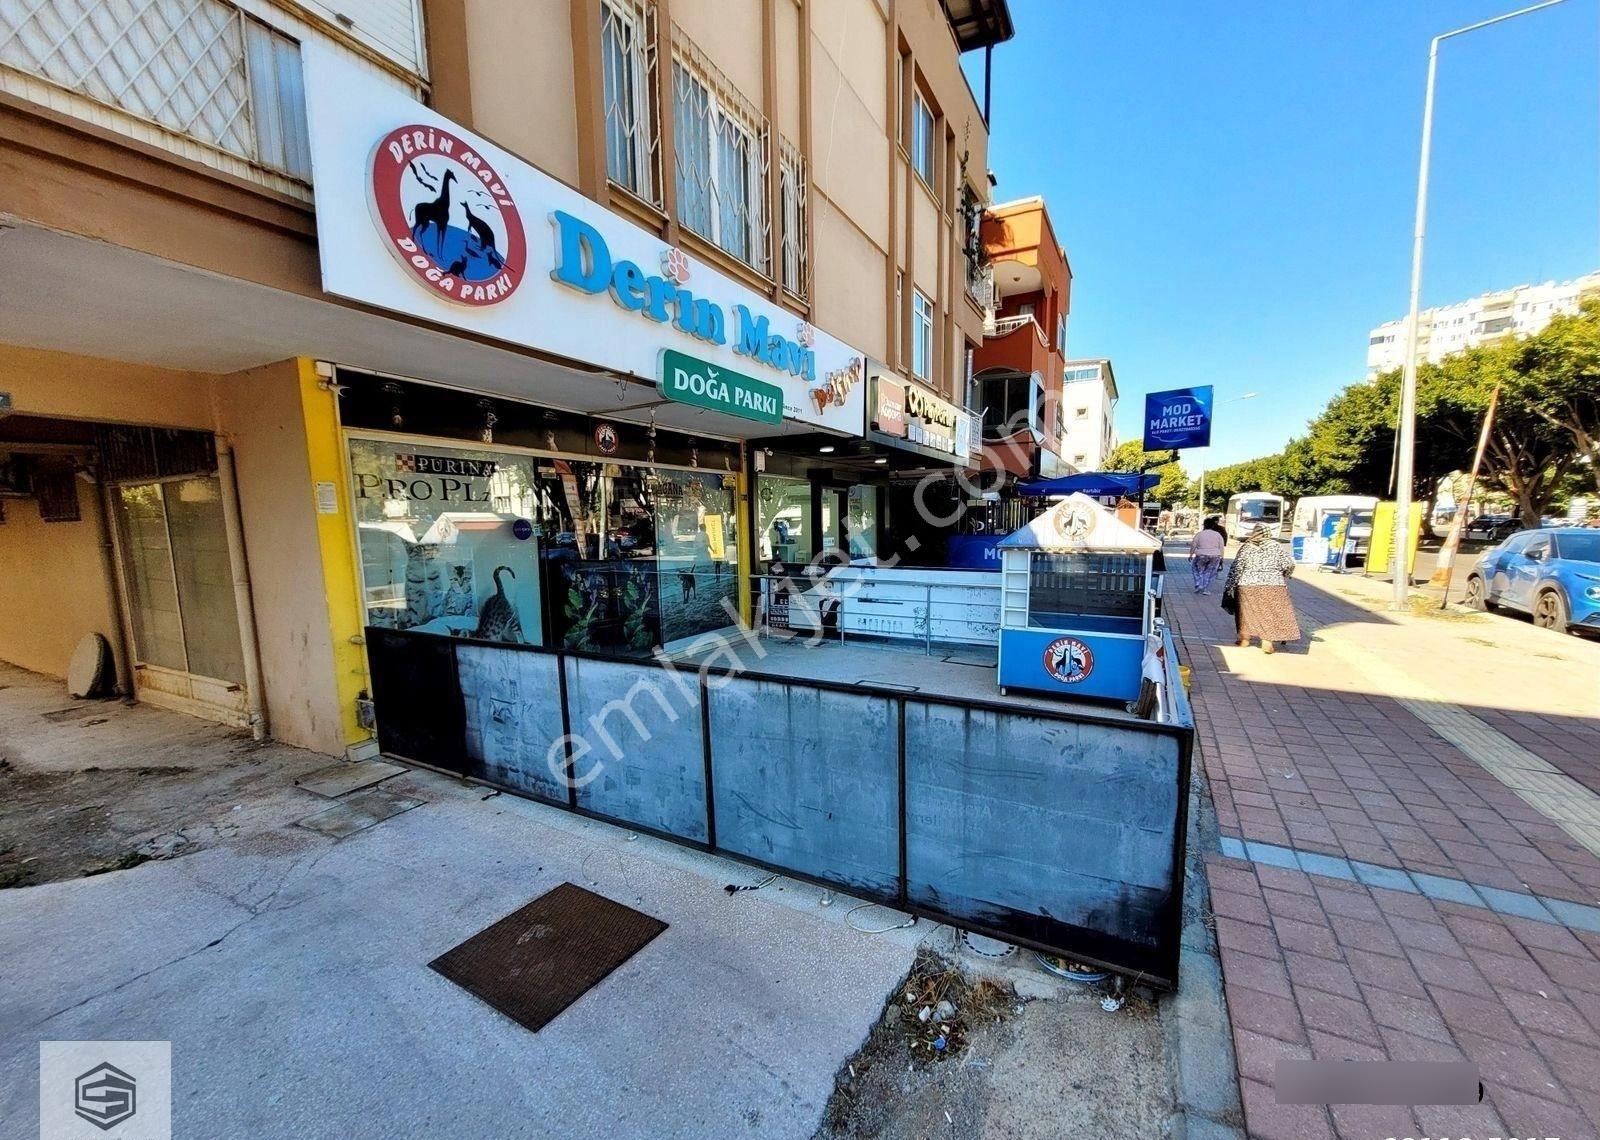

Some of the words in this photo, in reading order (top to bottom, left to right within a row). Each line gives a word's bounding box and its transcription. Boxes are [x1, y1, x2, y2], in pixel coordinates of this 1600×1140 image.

[397, 237, 454, 291] DOĞA
[460, 273, 513, 300] PARKI
[547, 210, 726, 347] Derin
[732, 304, 816, 381] Mavi
[674, 366, 730, 403] DOĞA
[734, 387, 776, 416] PARKI
[1150, 414, 1203, 430] MARKET
[1162, 403, 1191, 417] MOD
[418, 457, 494, 478] PURINA
[354, 473, 432, 501] PRO
